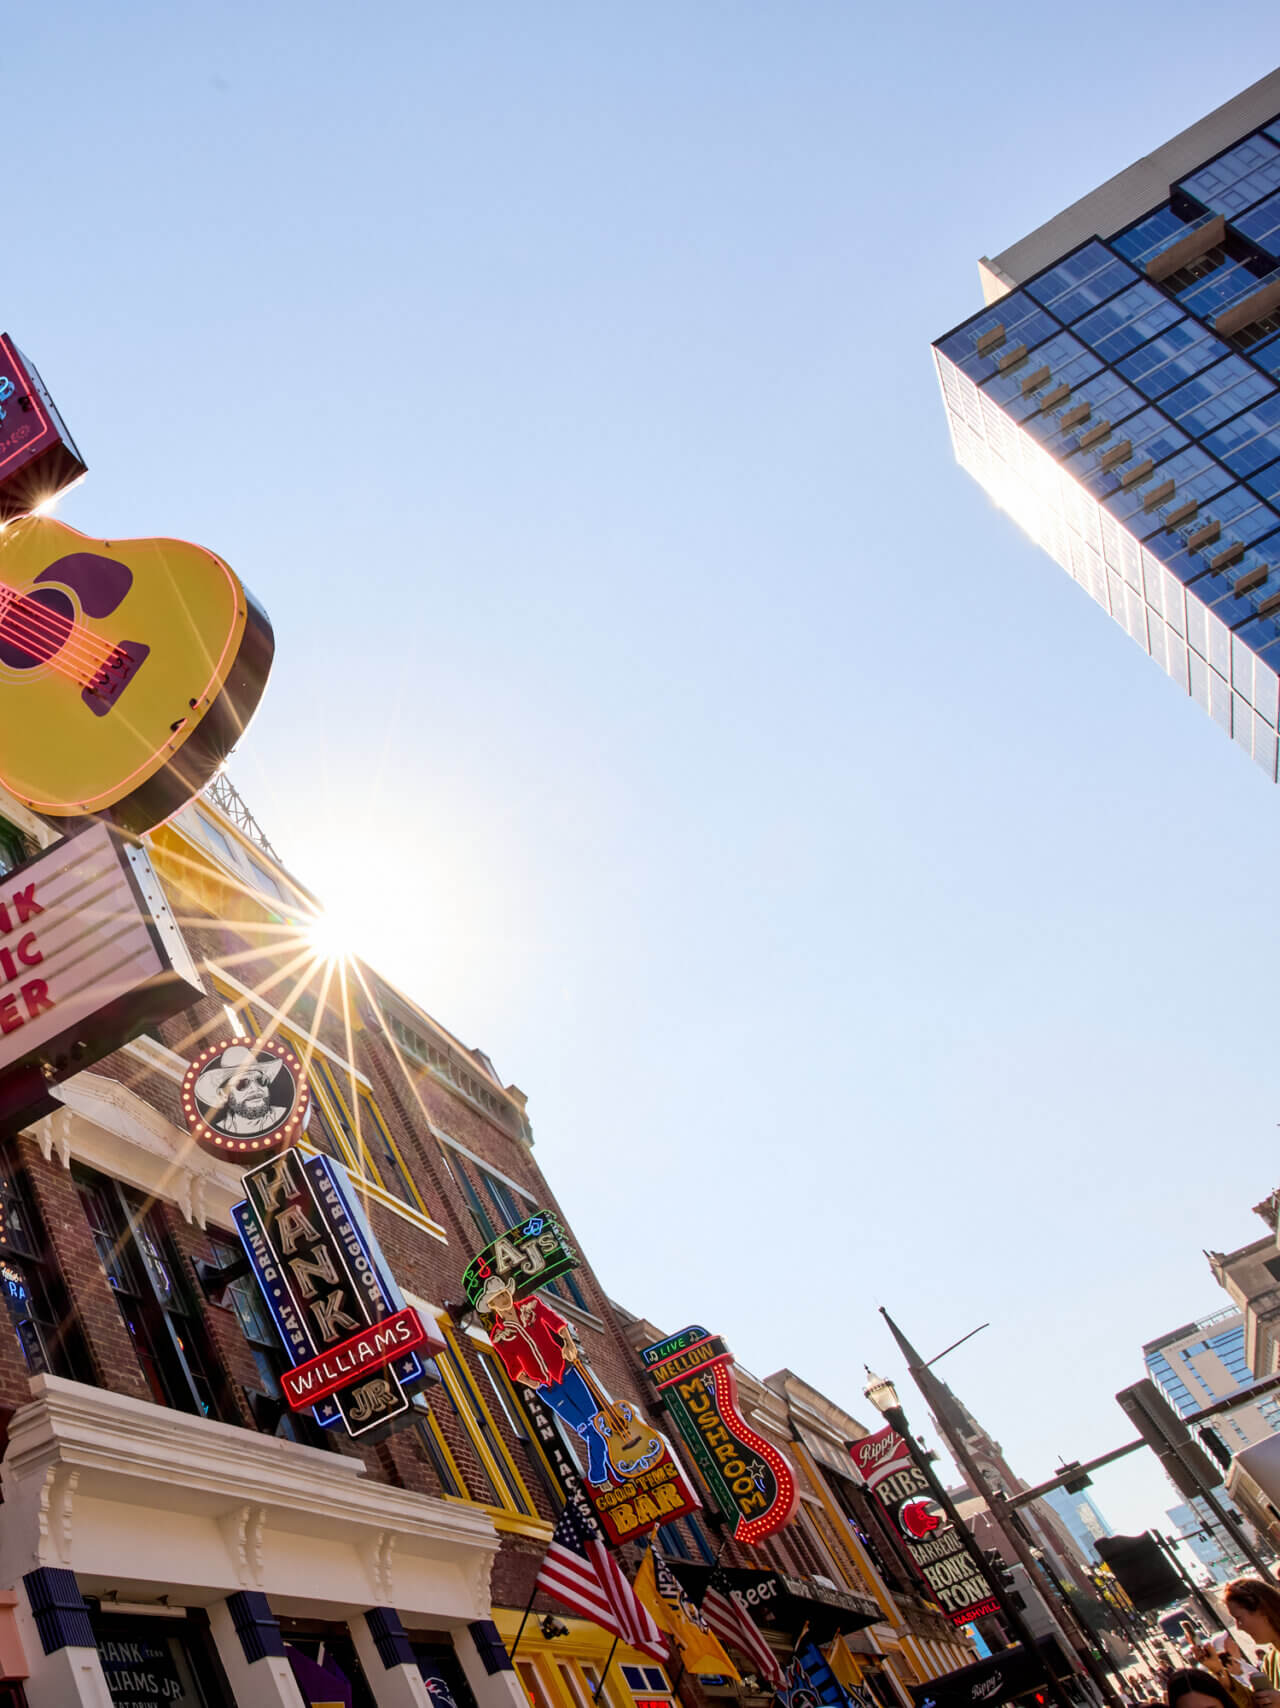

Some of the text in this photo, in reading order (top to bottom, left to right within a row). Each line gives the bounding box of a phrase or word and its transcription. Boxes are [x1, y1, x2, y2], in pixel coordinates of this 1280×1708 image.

[249, 1160, 360, 1344] HANK
[318, 1179, 382, 1303] BOOGIE BAR
[246, 1221, 306, 1345] EAT DRINK
[289, 1320, 413, 1396] WILLIAMS
[652, 1343, 715, 1385] MELLOW
[660, 1337, 686, 1357] LIVE
[348, 1378, 401, 1421] JR
[523, 1387, 607, 1541] ALAN JACKSO
[679, 1377, 768, 1516] MUSHROOM
[595, 1462, 680, 1512] GOOD TIME
[875, 1467, 930, 1506] RIBS
[608, 1482, 686, 1536] BAR
[906, 1528, 966, 1567] BARBEQU
[736, 1578, 777, 1611] Beer
[952, 1602, 1001, 1628] NASHVILL
[96, 1640, 144, 1664] HANK
[161, 1677, 184, 1702] JR
